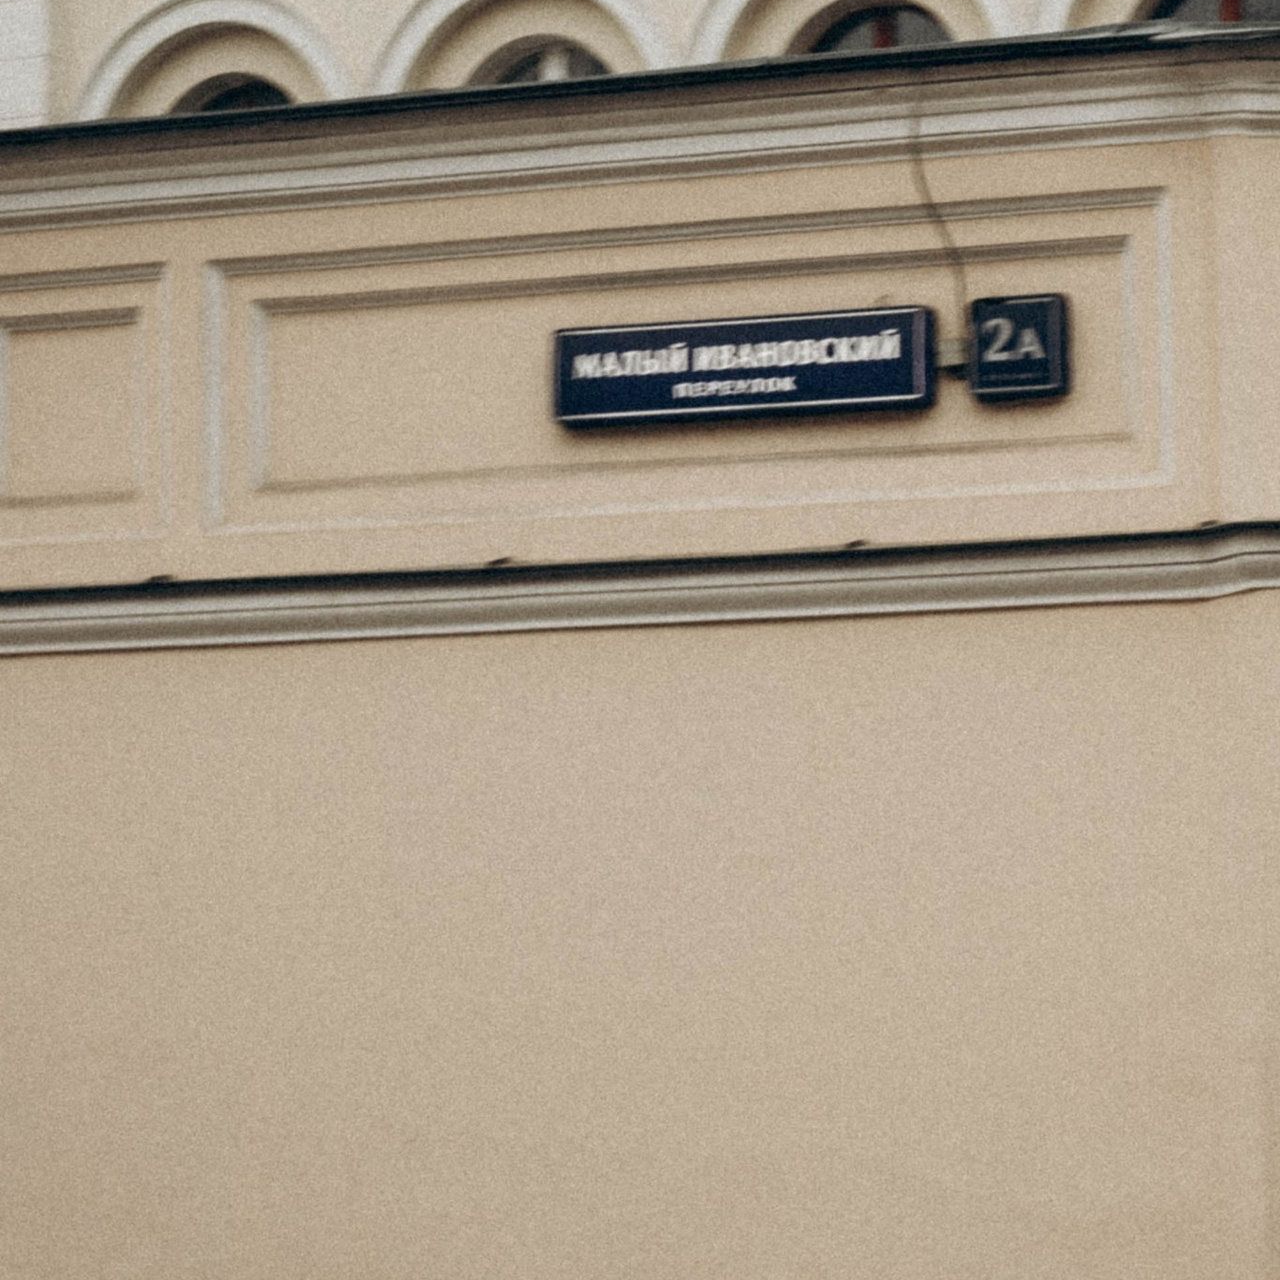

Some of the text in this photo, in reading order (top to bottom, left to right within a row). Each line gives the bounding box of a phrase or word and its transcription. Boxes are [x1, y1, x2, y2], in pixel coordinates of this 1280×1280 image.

[572, 328, 901, 379] МАЛЫЙ ИВАНОВСКИЙ
[982, 318, 1046, 362] 2А
